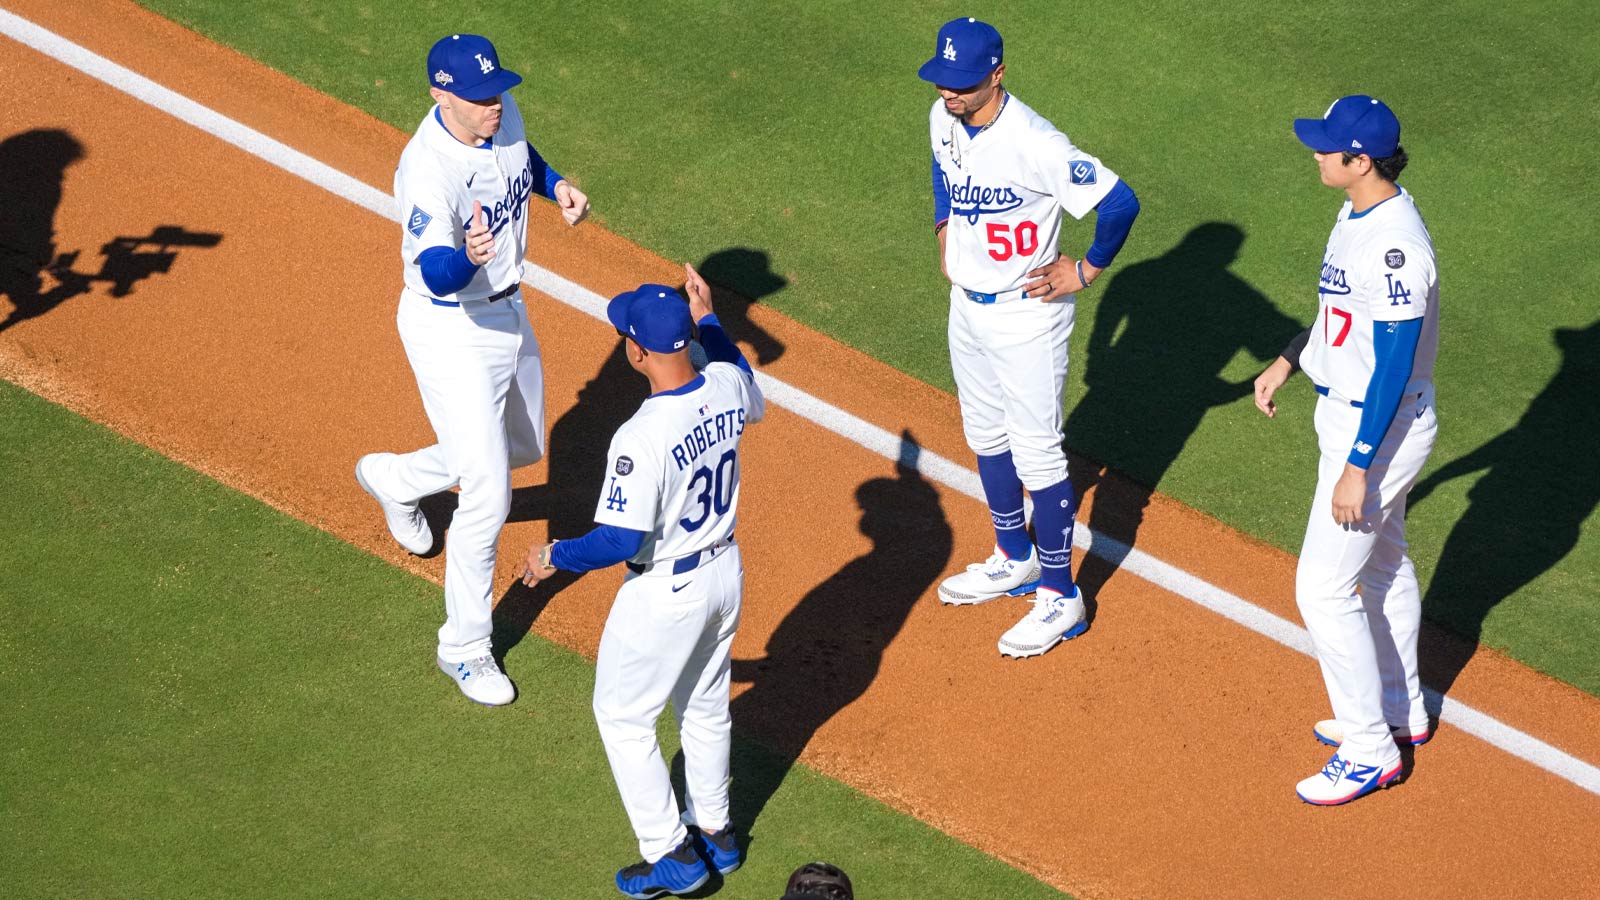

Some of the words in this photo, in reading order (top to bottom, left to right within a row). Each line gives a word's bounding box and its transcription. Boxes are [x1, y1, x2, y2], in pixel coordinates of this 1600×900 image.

[475, 53, 495, 75] LA
[943, 37, 957, 61] LA
[463, 158, 533, 231] Dodge
[986, 220, 1039, 262] 50
[1384, 273, 1412, 306] LA
[1324, 304, 1352, 347] 17
[671, 407, 745, 472] ROBERTS
[606, 476, 628, 513] LA
[679, 448, 737, 533] 30
